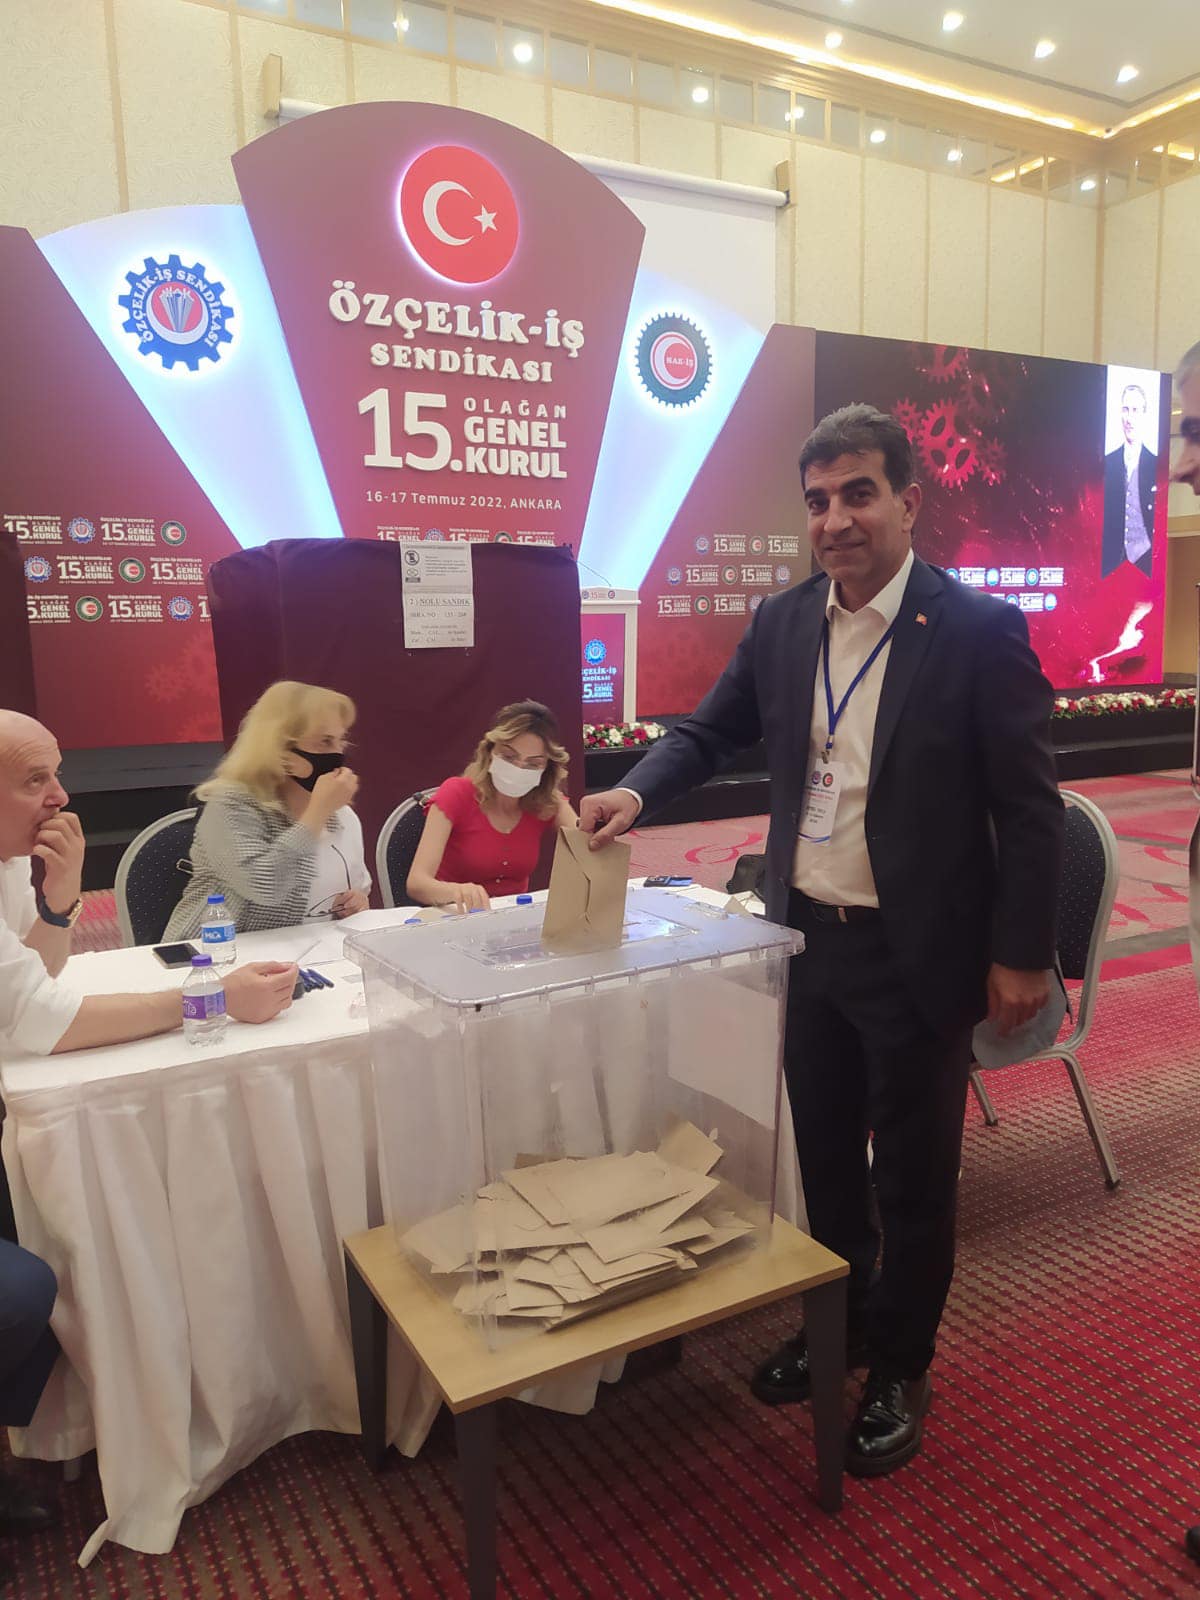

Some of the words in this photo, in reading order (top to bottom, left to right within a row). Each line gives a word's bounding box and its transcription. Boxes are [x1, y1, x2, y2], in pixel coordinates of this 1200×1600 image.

[176, 269, 222, 347] SENDİKASI
[329, 280, 584, 358] ÖZÇELİK-İŞ
[370, 343, 553, 382] SENDİKASI
[463, 397, 566, 418] OLAĞAN
[358, 387, 463, 472] 15.
[463, 416, 567, 448] GENEL
[465, 447, 567, 478] KURUL
[366, 490, 407, 504] 16-17
[412, 492, 466, 506] Temmuz
[470, 495, 507, 509] 2022,
[510, 498, 562, 510] ANKARA
